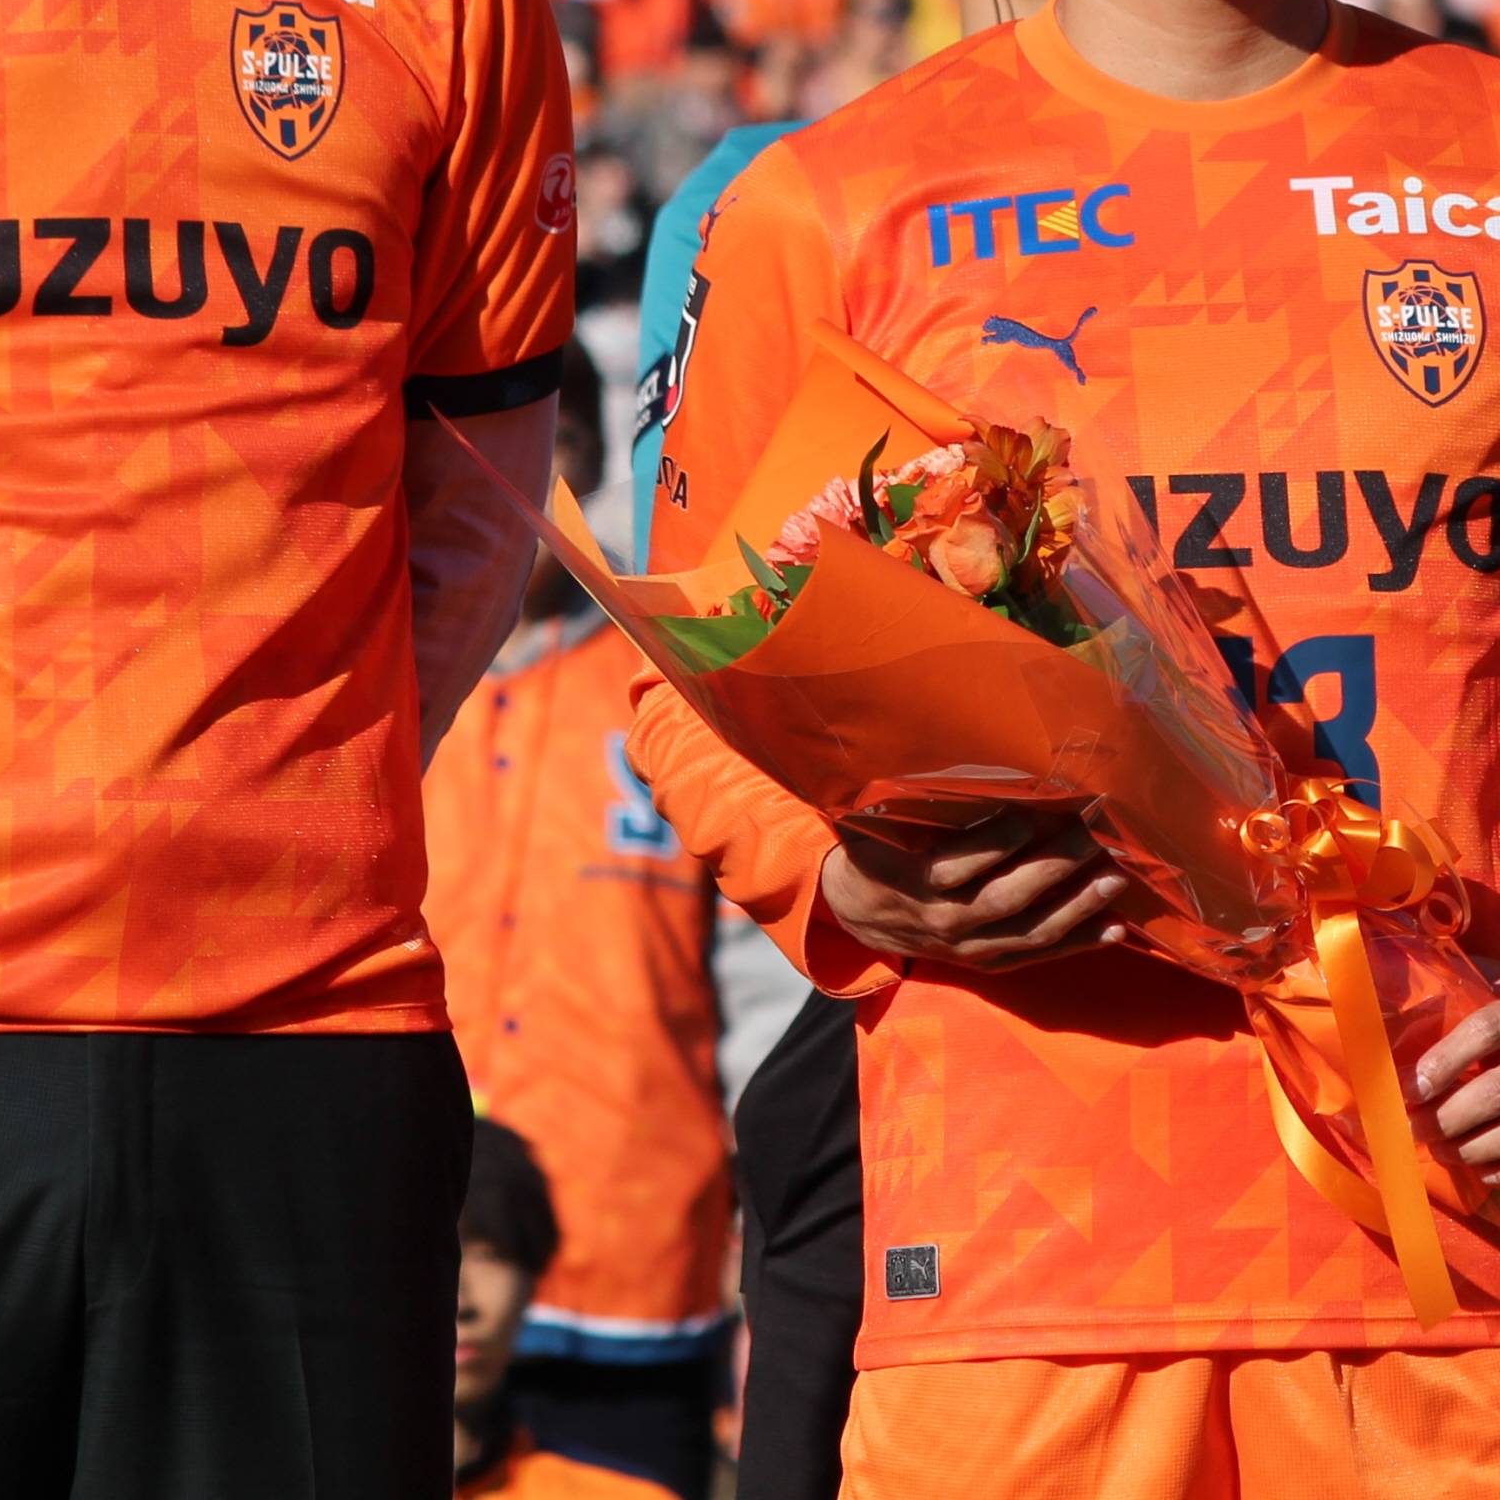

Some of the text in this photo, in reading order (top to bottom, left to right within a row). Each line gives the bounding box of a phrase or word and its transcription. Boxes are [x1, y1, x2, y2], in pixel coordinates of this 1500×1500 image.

[241, 49, 332, 80] S-PULSE
[927, 184, 1135, 267] ITEC
[1376, 304, 1476, 330] S-PULSE
[1380, 331, 1476, 345] SHIZUOKA SHIMIZU
